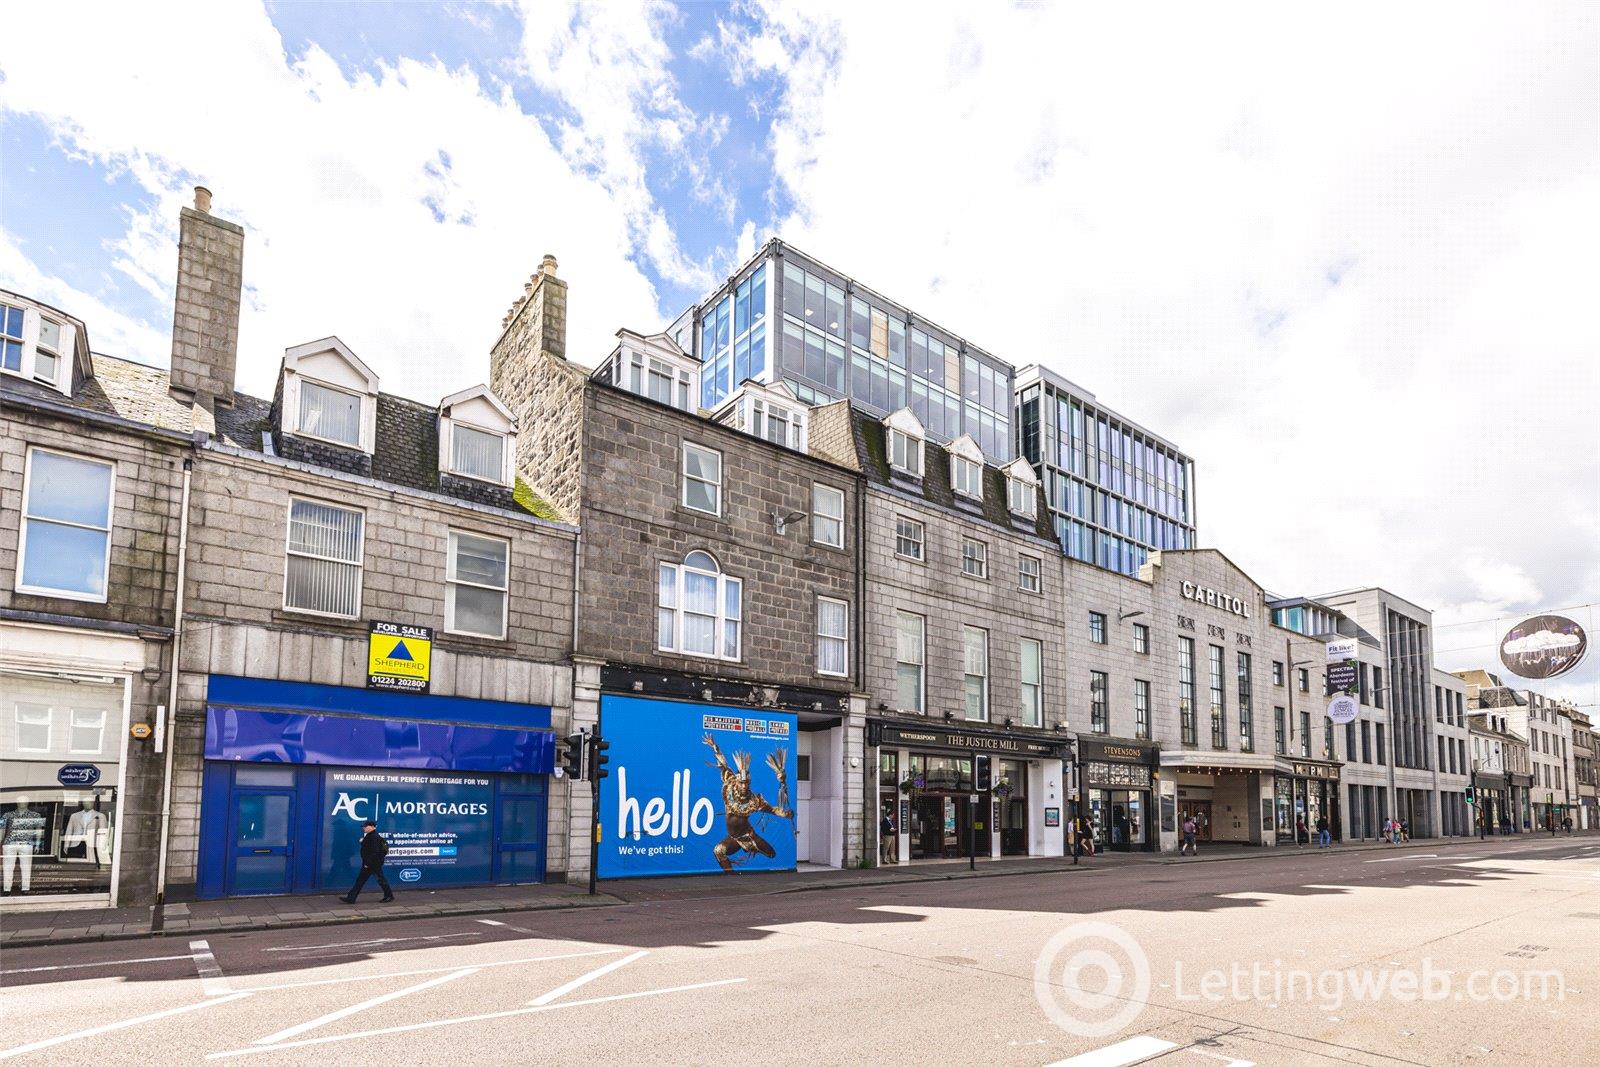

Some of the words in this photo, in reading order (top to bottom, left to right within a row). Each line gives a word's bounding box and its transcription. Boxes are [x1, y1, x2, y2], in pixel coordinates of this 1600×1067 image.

[1182, 580, 1250, 618] CAPITOL
[376, 622, 398, 633] FOR
[401, 625, 427, 637] SALE
[374, 657, 425, 671] SHEPHERD
[371, 675, 395, 685] 01224
[397, 678, 426, 688] 202800
[899, 732, 937, 742] WETHERSPOON
[946, 734, 964, 746] THE
[965, 736, 998, 749] JUSTICE
[999, 739, 1019, 751] MILL
[1103, 746, 1142, 757] STEVENSONS
[333, 773, 345, 781] WE
[346, 773, 385, 782] GUARANTEE
[400, 776, 428, 784] PERFECT
[429, 777, 463, 785] MORTGAGE
[476, 778, 489, 786] YOU
[331, 792, 369, 821] AC
[385, 801, 488, 816] MORTGAGES
[617, 766, 714, 841] hello
[618, 845, 647, 855] We've
[647, 844, 663, 857] got
[664, 844, 684, 855] this!
